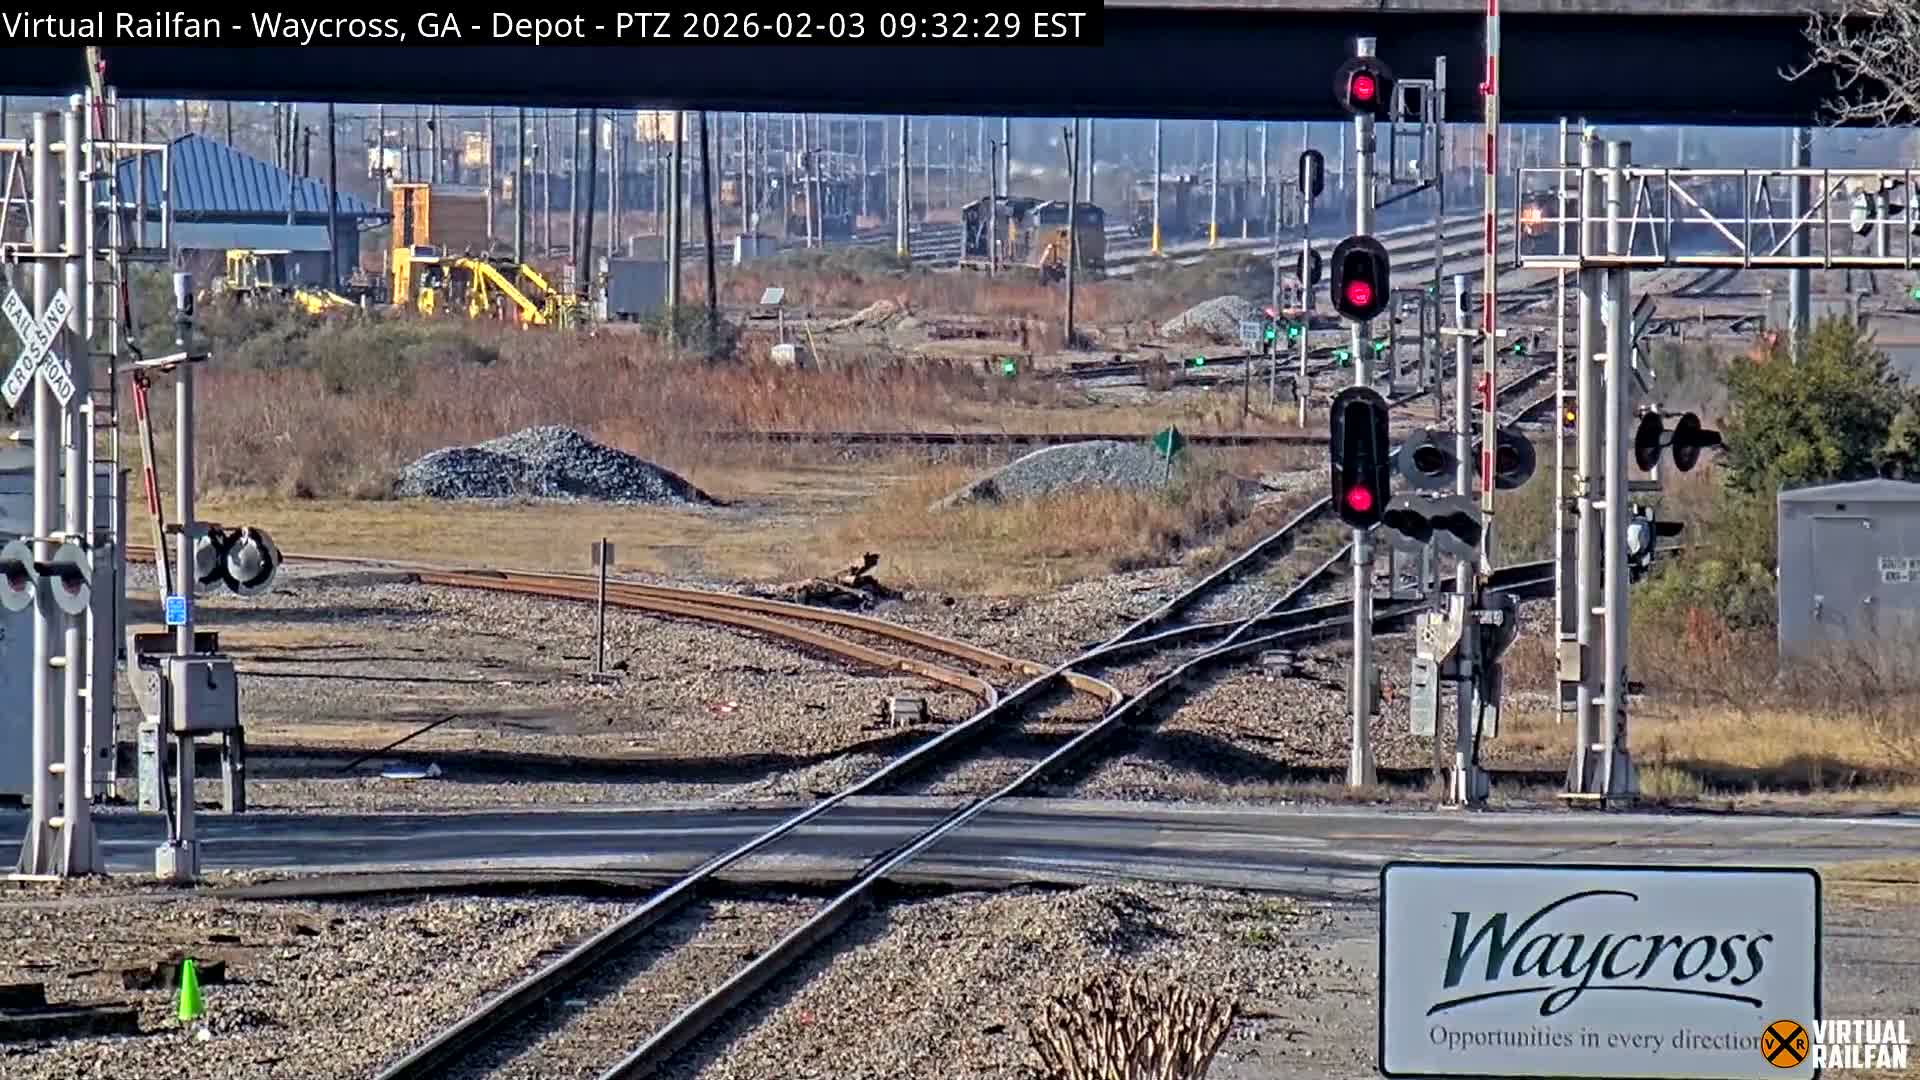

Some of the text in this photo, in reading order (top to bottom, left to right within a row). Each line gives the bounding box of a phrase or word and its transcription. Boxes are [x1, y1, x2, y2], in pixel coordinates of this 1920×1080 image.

[6, 297, 72, 397] RAIL ROAD
[8, 299, 66, 396] CROSSING
[1443, 889, 1773, 1016] Waycross
[1430, 1024, 1573, 1051] Opportunities
[1581, 1026, 1600, 1048] in
[1607, 1033, 1663, 1053] every
